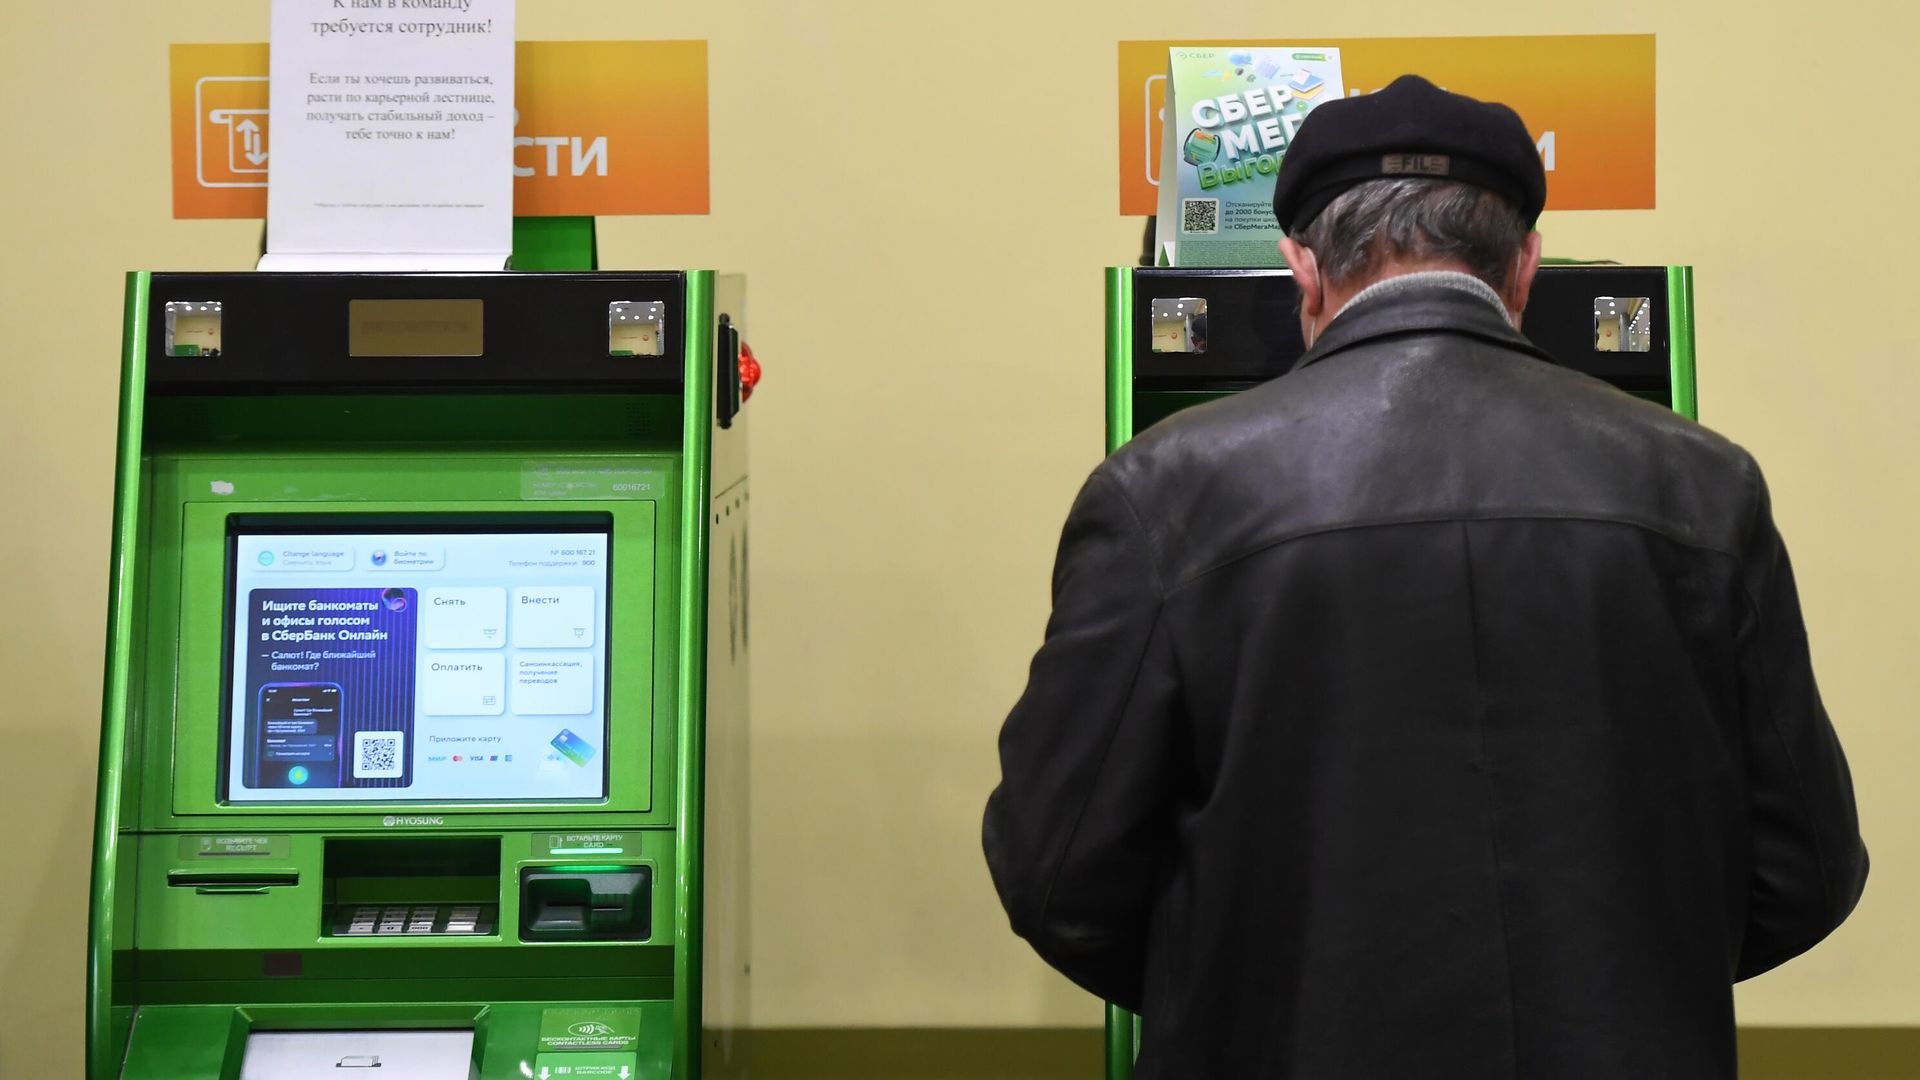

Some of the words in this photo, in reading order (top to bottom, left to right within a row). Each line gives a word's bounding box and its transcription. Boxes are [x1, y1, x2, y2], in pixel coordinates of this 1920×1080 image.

[333, 0, 345, 9] К
[351, 0, 382, 9] нам
[388, 0, 396, 9] в
[401, 0, 473, 13] команду
[311, 18, 393, 37] требуется
[399, 18, 492, 37] сотрудник!
[309, 72, 340, 84] Если
[344, 74, 360, 84] ты
[364, 74, 411, 85] хочешь
[414, 74, 494, 87] развиваться,
[306, 94, 342, 106] расти
[345, 94, 362, 103] по
[365, 91, 430, 106] карьерной
[433, 94, 495, 105] лестнице,
[1191, 84, 1295, 129] СБЕР
[306, 111, 365, 124] получать
[367, 109, 442, 122] стабильный
[445, 112, 484, 123] доход
[345, 127, 372, 140] тебе
[376, 129, 413, 140] точно
[416, 129, 424, 140] к
[427, 128, 456, 140] нам!
[1225, 200, 1271, 209] Отсканируйте
[282, 550, 309, 558] Change
[311, 550, 344, 558] language
[262, 600, 306, 612] Ищите
[308, 599, 379, 611] банкоматы
[433, 597, 466, 606] Снять
[521, 595, 560, 605] Внести
[261, 617, 271, 626] и
[273, 614, 315, 628] офисы
[317, 616, 370, 626] голосом
[261, 632, 270, 641] в
[271, 629, 336, 643] СберБанк
[338, 629, 388, 641] Онлайн
[271, 651, 304, 659] Салют!
[305, 650, 322, 660] Где
[322, 650, 376, 659] ближайший
[271, 662, 320, 671] банкомат?
[430, 662, 483, 672] Оплатить
[428, 735, 477, 744] Приложите
[478, 735, 502, 744] карту
[396, 816, 444, 825] HYOSUNG
